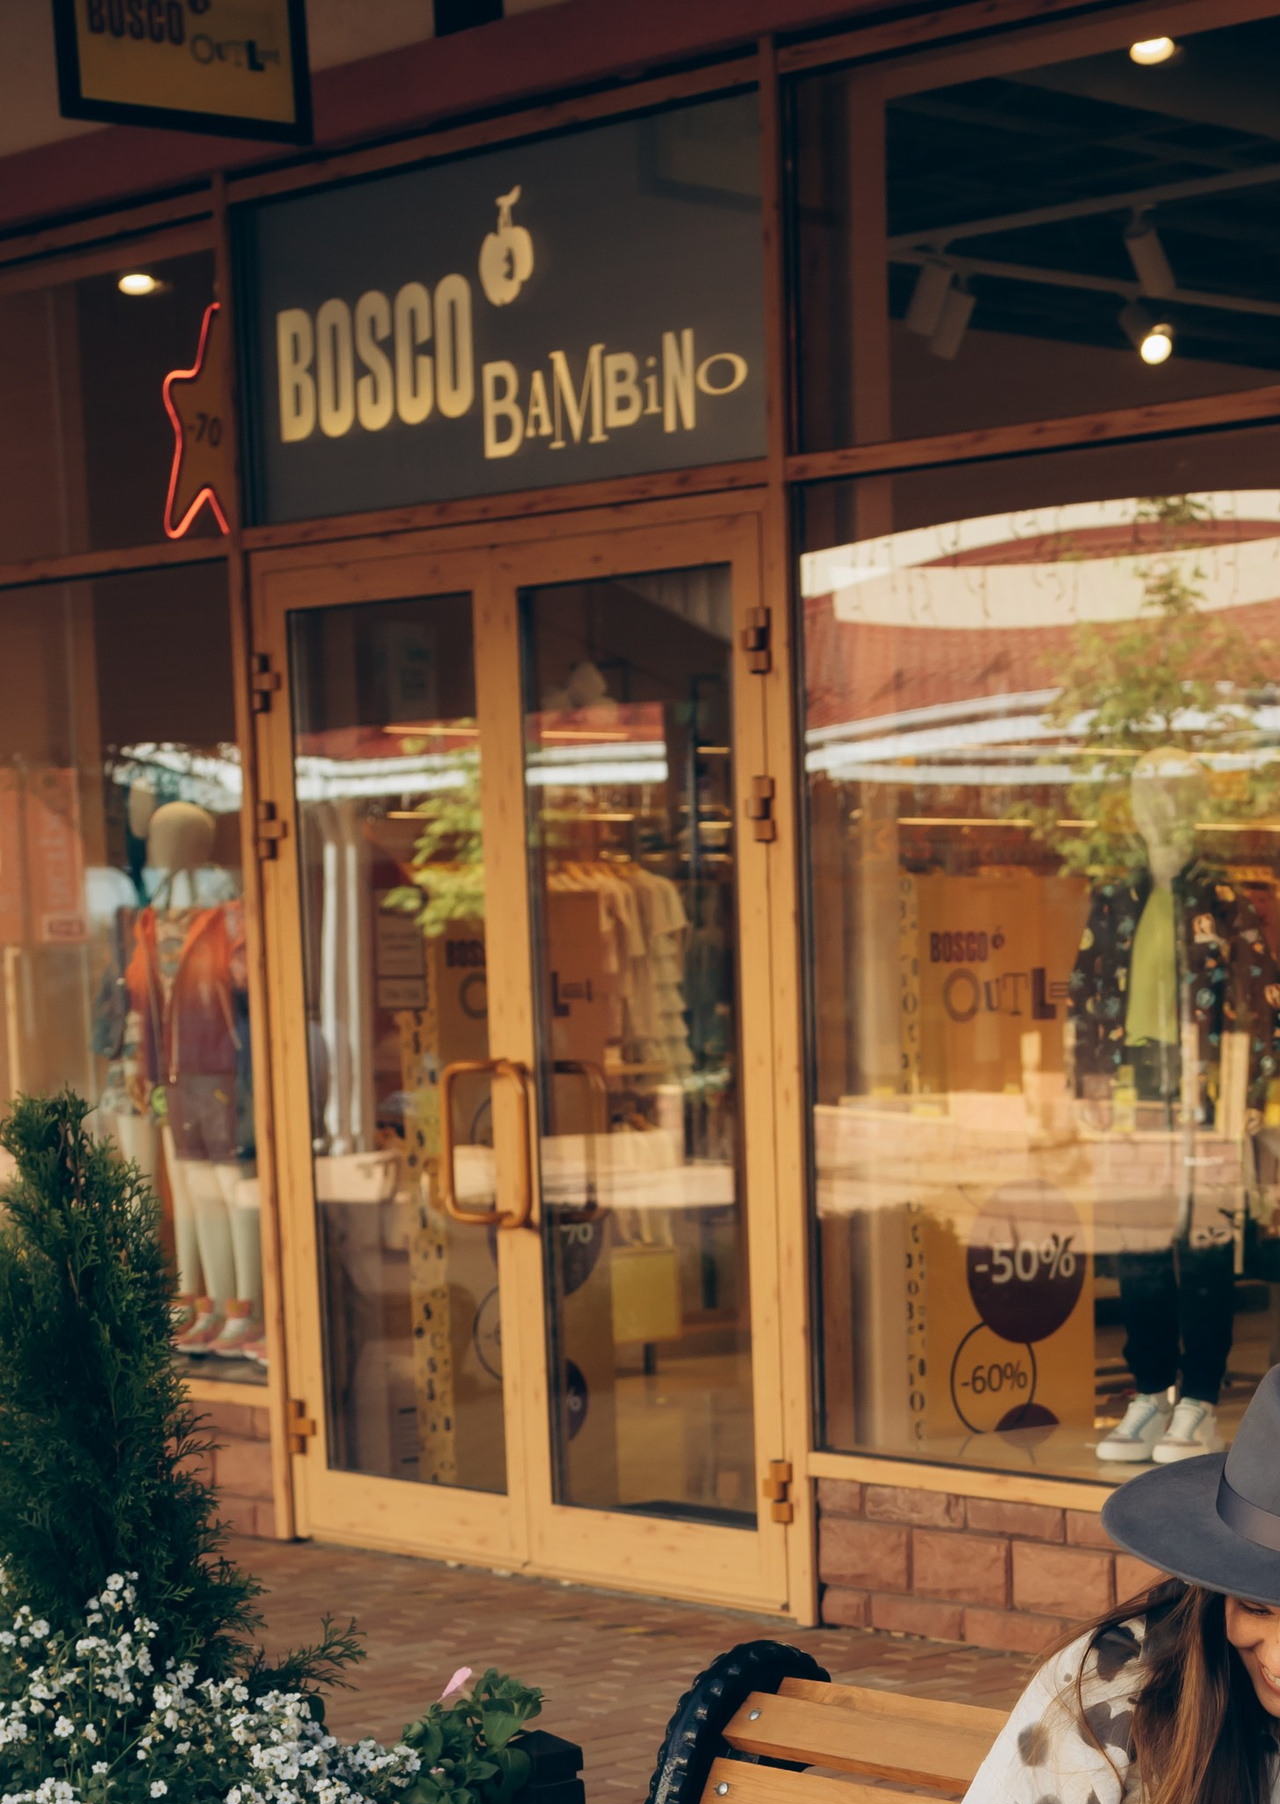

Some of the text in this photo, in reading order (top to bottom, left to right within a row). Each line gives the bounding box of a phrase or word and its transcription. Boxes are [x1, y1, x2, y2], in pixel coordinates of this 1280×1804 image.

[276, 273, 475, 444] BOSCO
[930, 931, 989, 963] BOSCO
[975, 1240, 1076, 1284] -50%
[961, 1361, 1028, 1394] -60%
